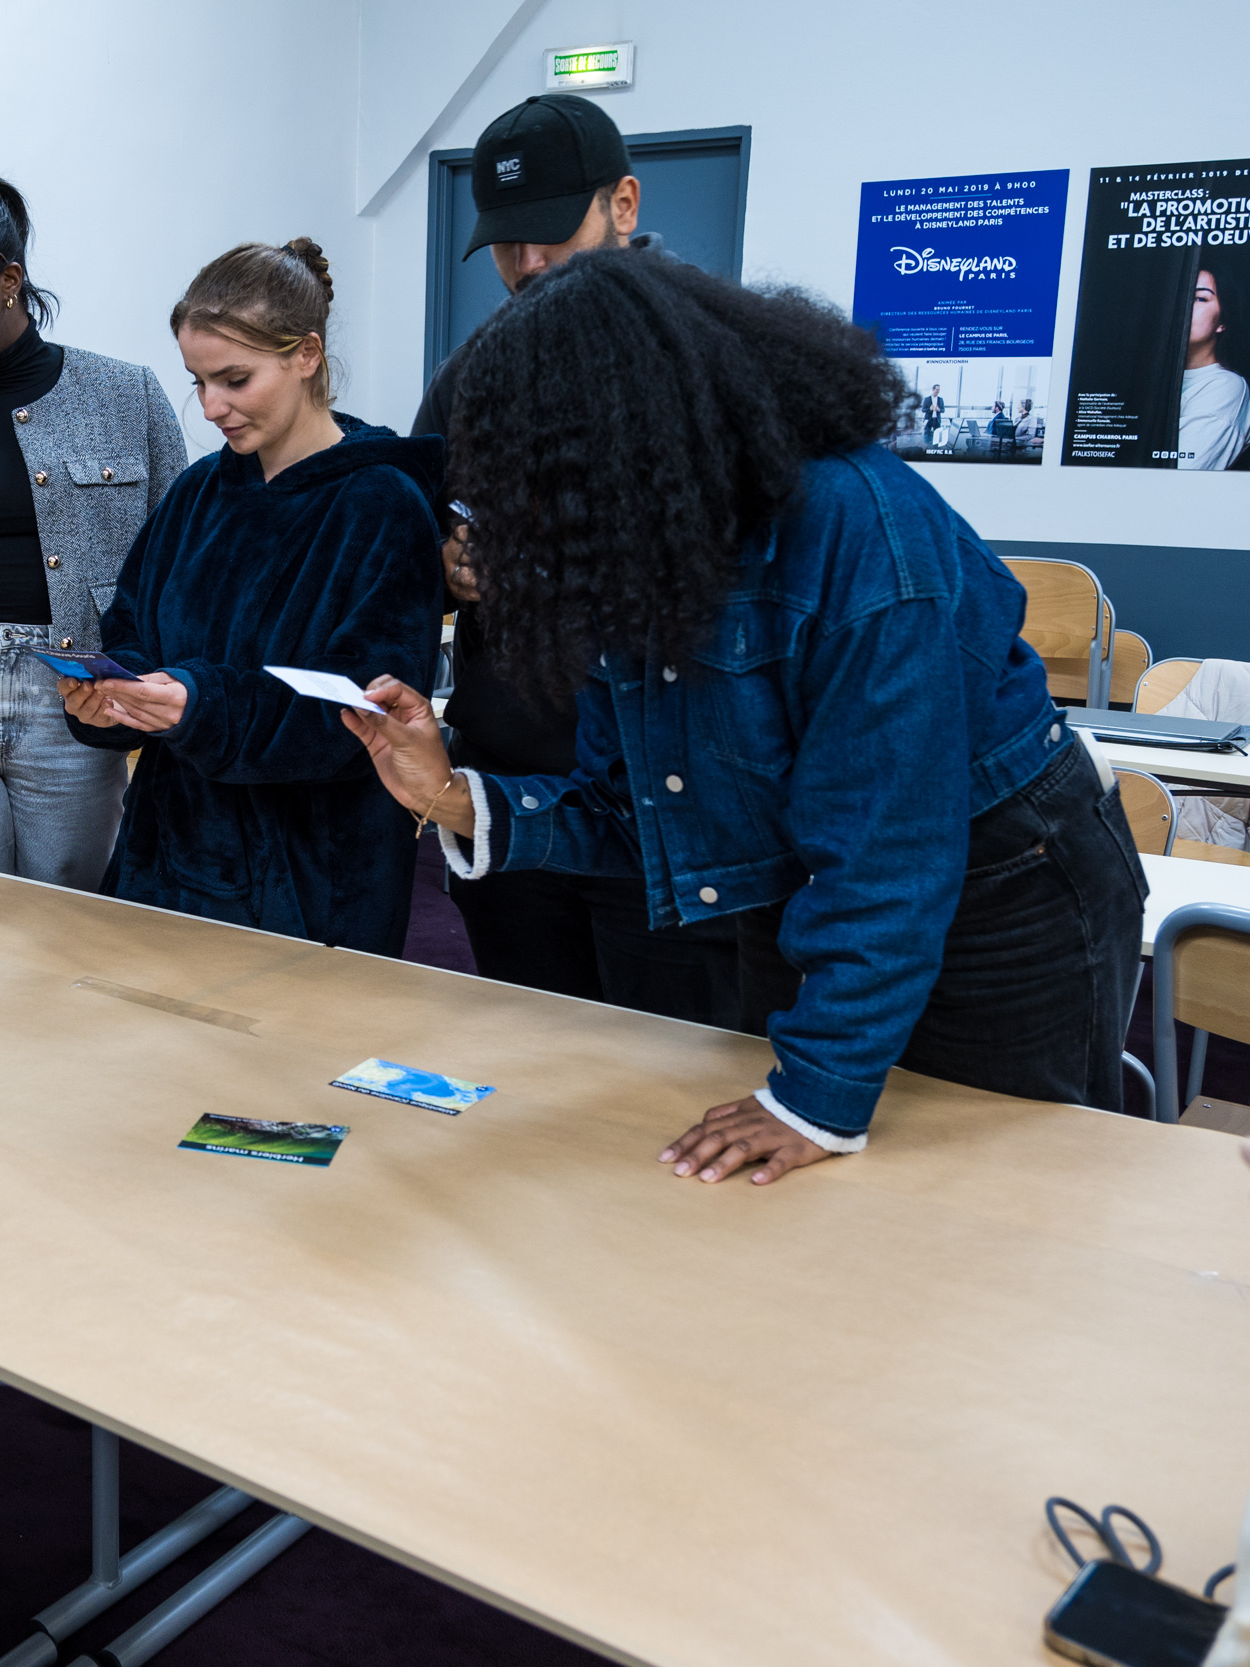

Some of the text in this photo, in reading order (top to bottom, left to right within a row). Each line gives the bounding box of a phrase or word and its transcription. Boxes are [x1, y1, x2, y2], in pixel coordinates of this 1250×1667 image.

[555, 57, 578, 73] SORTIE
[587, 53, 618, 70] SECOURS
[496, 158, 521, 174] NYC
[1146, 172, 1195, 181] FÉVRIER
[1201, 170, 1228, 178] 2019
[883, 189, 915, 197] LUNDI
[921, 187, 933, 195] 20
[964, 184, 989, 192] 2019
[994, 182, 1001, 190] À
[1007, 181, 1036, 189] 9H00
[1130, 189, 1204, 201] MASTERCLASS
[907, 201, 966, 211] MANAGEMENT
[967, 200, 984, 208] DES
[986, 198, 1024, 207] TALENTS
[1120, 197, 1250, 217] "LA PROMOTI
[883, 214, 893, 222] LE
[895, 211, 966, 221] DÉVELOPPEMENT
[985, 206, 1049, 217] COMPÉTENCES
[915, 218, 1003, 229] À DISNEYLAND PARIS
[1142, 213, 1250, 232] DE L’ARTIST
[1108, 229, 1250, 249] ET DE SON OEU
[968, 272, 1016, 280] PARIS
[1071, 450, 1116, 458] #TALKSTOISEFAC
[205, 1144, 304, 1163] Herbiers marins
